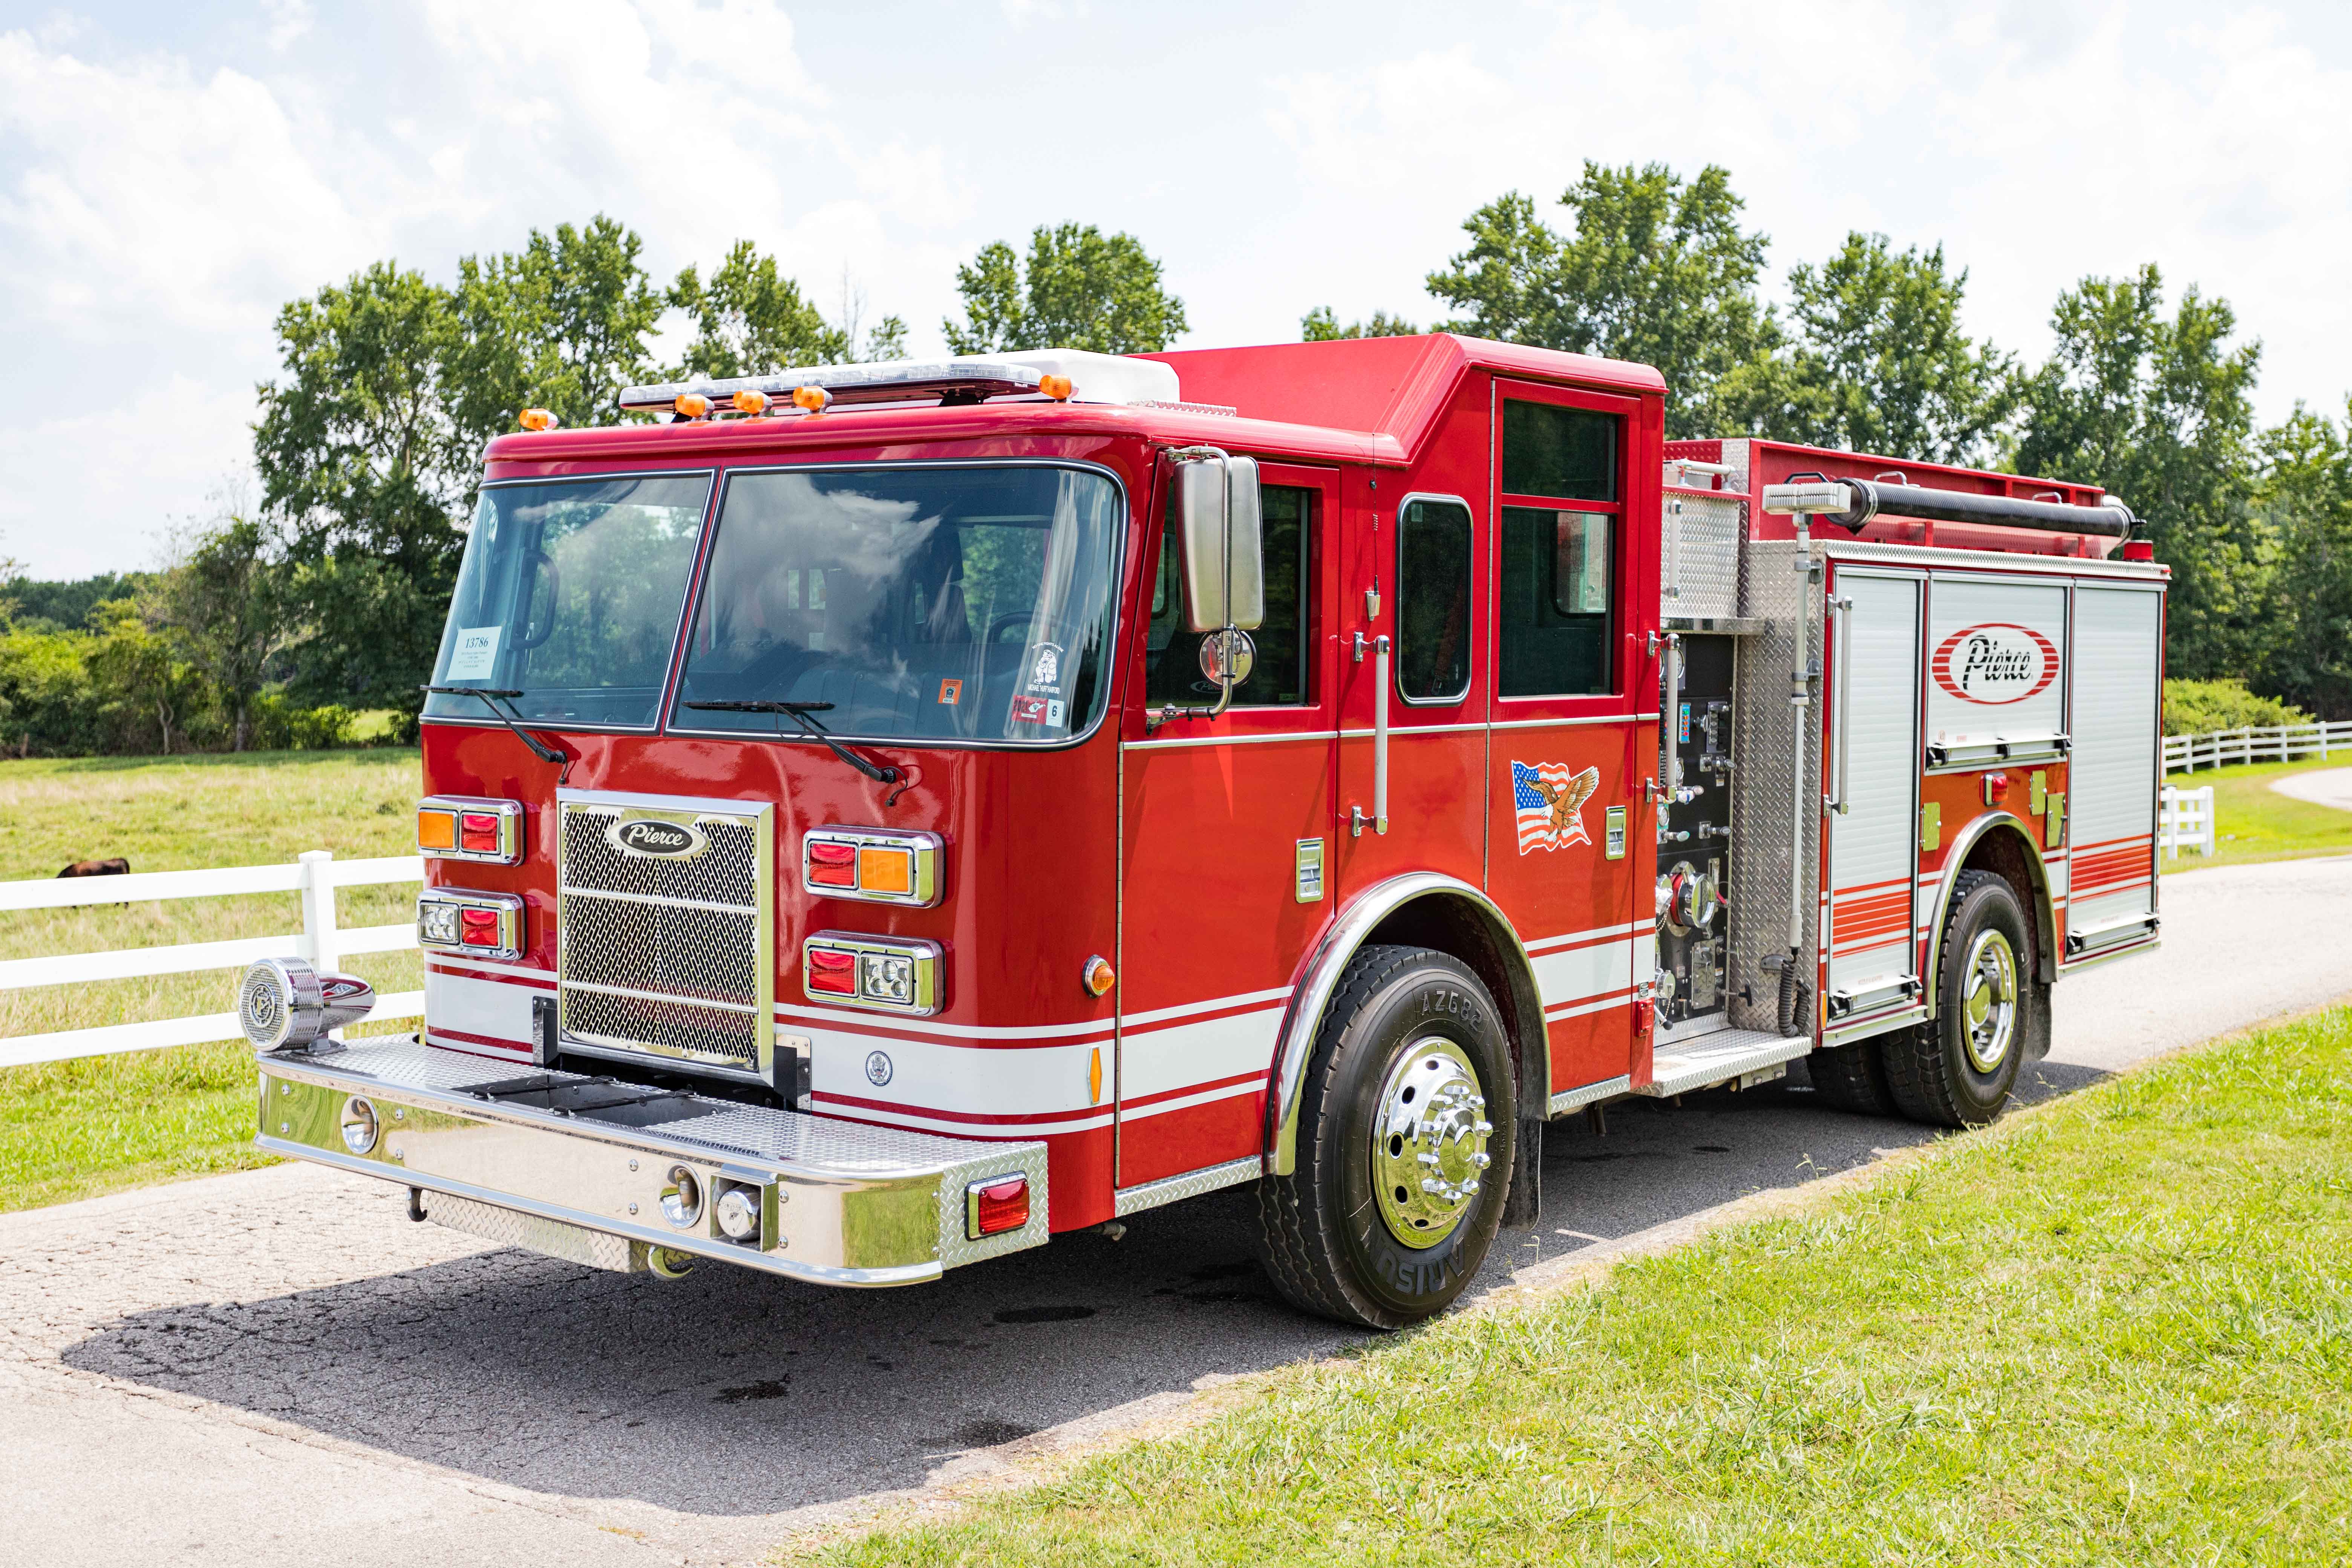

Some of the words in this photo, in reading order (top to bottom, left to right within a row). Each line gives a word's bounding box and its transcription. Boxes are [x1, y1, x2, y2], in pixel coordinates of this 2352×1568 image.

[466, 637, 489, 648] 13786
[1054, 644, 1064, 653] ALONE
[1963, 635, 2031, 690] Pierce
[1052, 705, 1058, 717] 6
[627, 824, 684, 846] Pierce
[1421, 988, 1482, 1032] AZ682
